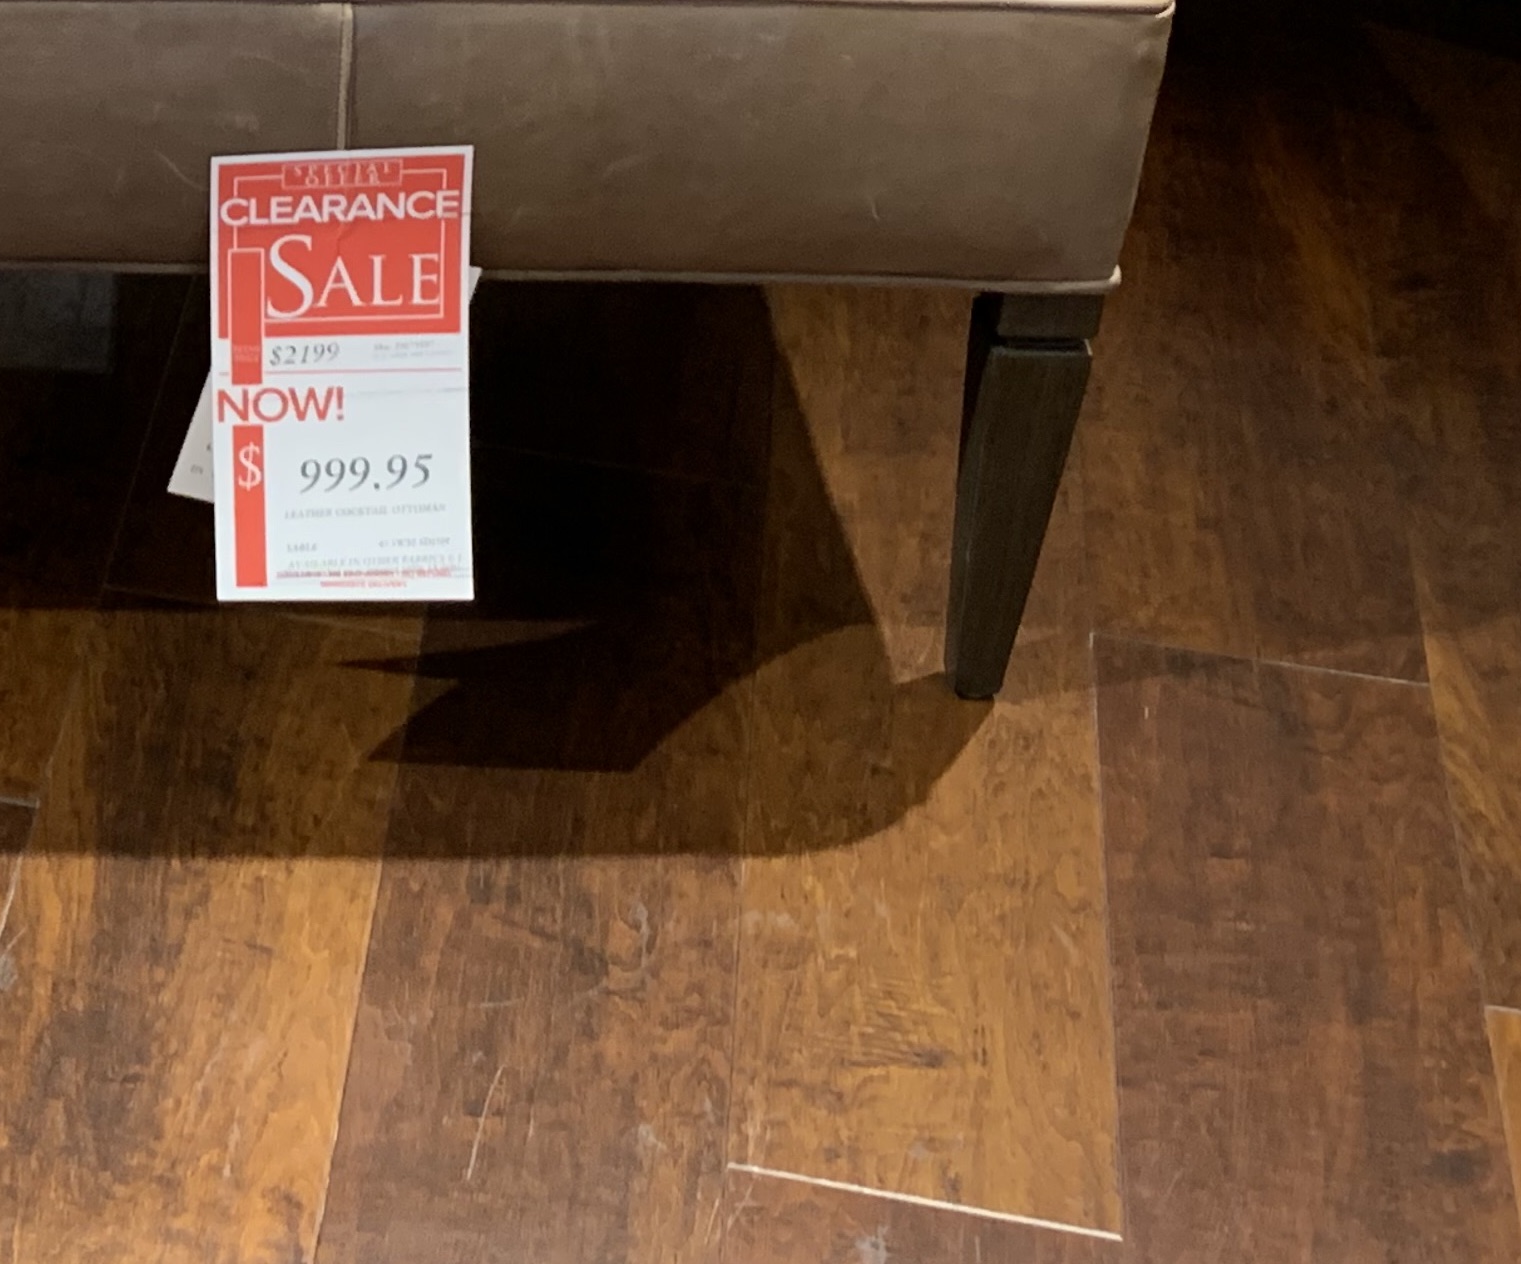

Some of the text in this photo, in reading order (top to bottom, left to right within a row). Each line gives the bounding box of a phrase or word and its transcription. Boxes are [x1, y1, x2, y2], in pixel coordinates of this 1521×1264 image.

[220, 189, 460, 226] CLEARANCE
[269, 342, 340, 367] $2199
[217, 386, 345, 423] NOW!
[238, 441, 434, 494] $ 999.95
